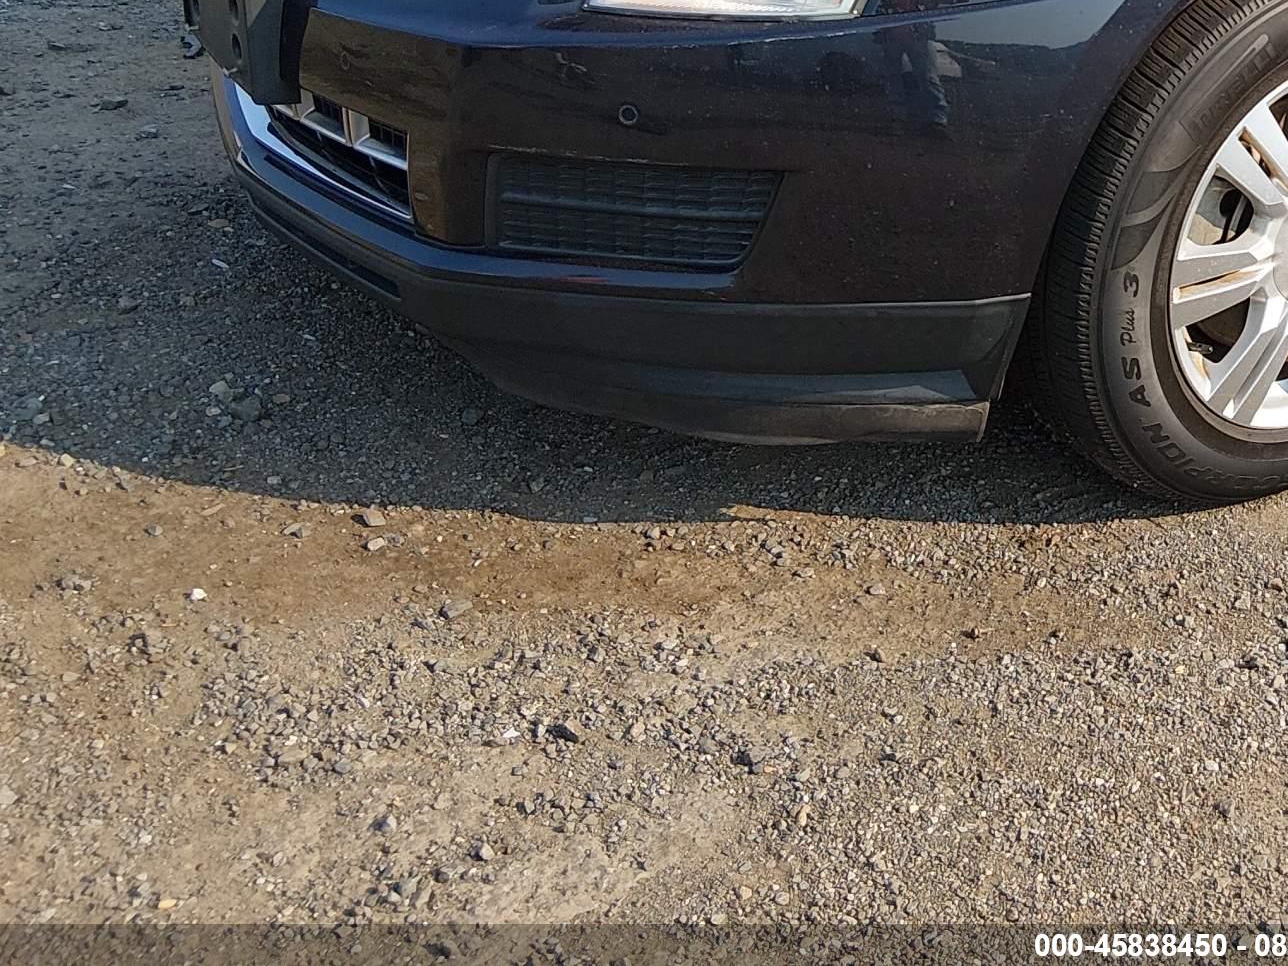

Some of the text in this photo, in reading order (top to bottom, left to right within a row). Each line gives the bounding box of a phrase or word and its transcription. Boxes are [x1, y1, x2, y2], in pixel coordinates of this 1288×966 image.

[1123, 270, 1139, 298] 3
[1119, 307, 1137, 347] Plus
[1121, 356, 1152, 407] AS
